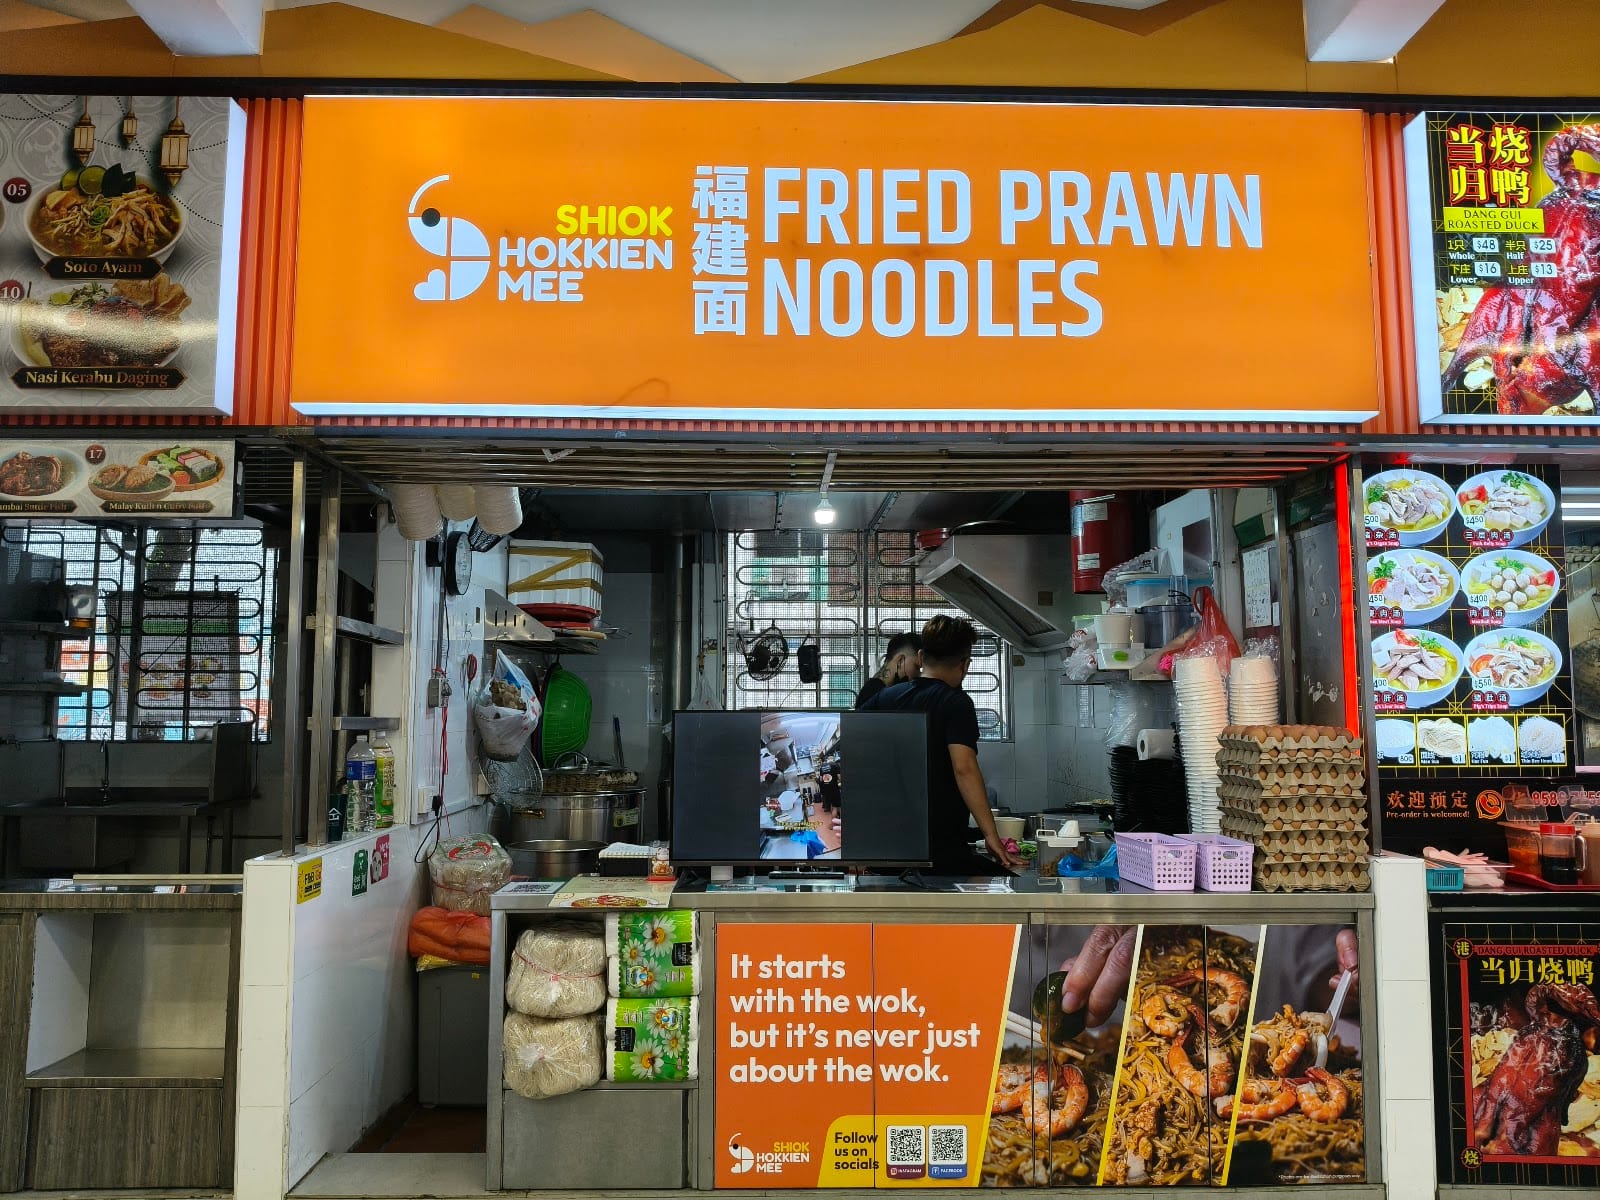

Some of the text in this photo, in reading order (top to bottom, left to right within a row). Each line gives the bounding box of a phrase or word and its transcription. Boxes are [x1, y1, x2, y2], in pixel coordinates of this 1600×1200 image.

[7, 184, 27, 196] 05
[764, 167, 1263, 248] FRIED PRAWN
[1464, 210, 1522, 219] DANG GUI
[556, 205, 673, 237] SHIOK
[1448, 220, 1540, 230] ROASTED DUCK
[691, 166, 749, 336] 福建面
[1448, 239, 1553, 251] 1只 $48 半只 $25
[499, 236, 673, 270] HOKKIEN
[1449, 252, 1524, 260] Whole Half
[64, 261, 142, 276] Soto Ayam
[1451, 263, 1553, 275] 下庄 $16 上庄 $13
[498, 271, 584, 302] MEE
[1450, 276, 1535, 286] Lower Upper
[1, 286, 21, 299] 10
[763, 258, 1104, 338] NOODLES
[26, 371, 170, 386] Nasi Kerabu Daging
[87, 449, 104, 460] 17
[109, 502, 135, 512] Malay
[1386, 790, 1469, 809] 欢迎预定
[1386, 811, 1420, 819] Pre-order
[1431, 811, 1470, 819] welcomed!
[1457, 942, 1470, 955] 港
[1478, 945, 1503, 955] DANG
[1524, 945, 1565, 955] ROASTED
[1566, 945, 1593, 956] DUCK
[731, 954, 846, 979] It starts
[1480, 957, 1594, 985] 当归烧鸭
[730, 987, 926, 1017] with the wok,
[730, 1022, 981, 1055] but it's never just
[729, 1056, 949, 1083] about the wok.
[834, 1132, 878, 1144] Follow
[773, 1141, 810, 1153] SHIOK
[834, 1147, 868, 1157] us on
[756, 1151, 810, 1163] HOKKIEN
[1464, 1151, 1478, 1166] 烧
[756, 1162, 783, 1173] MEE
[834, 1158, 880, 1170] socials
